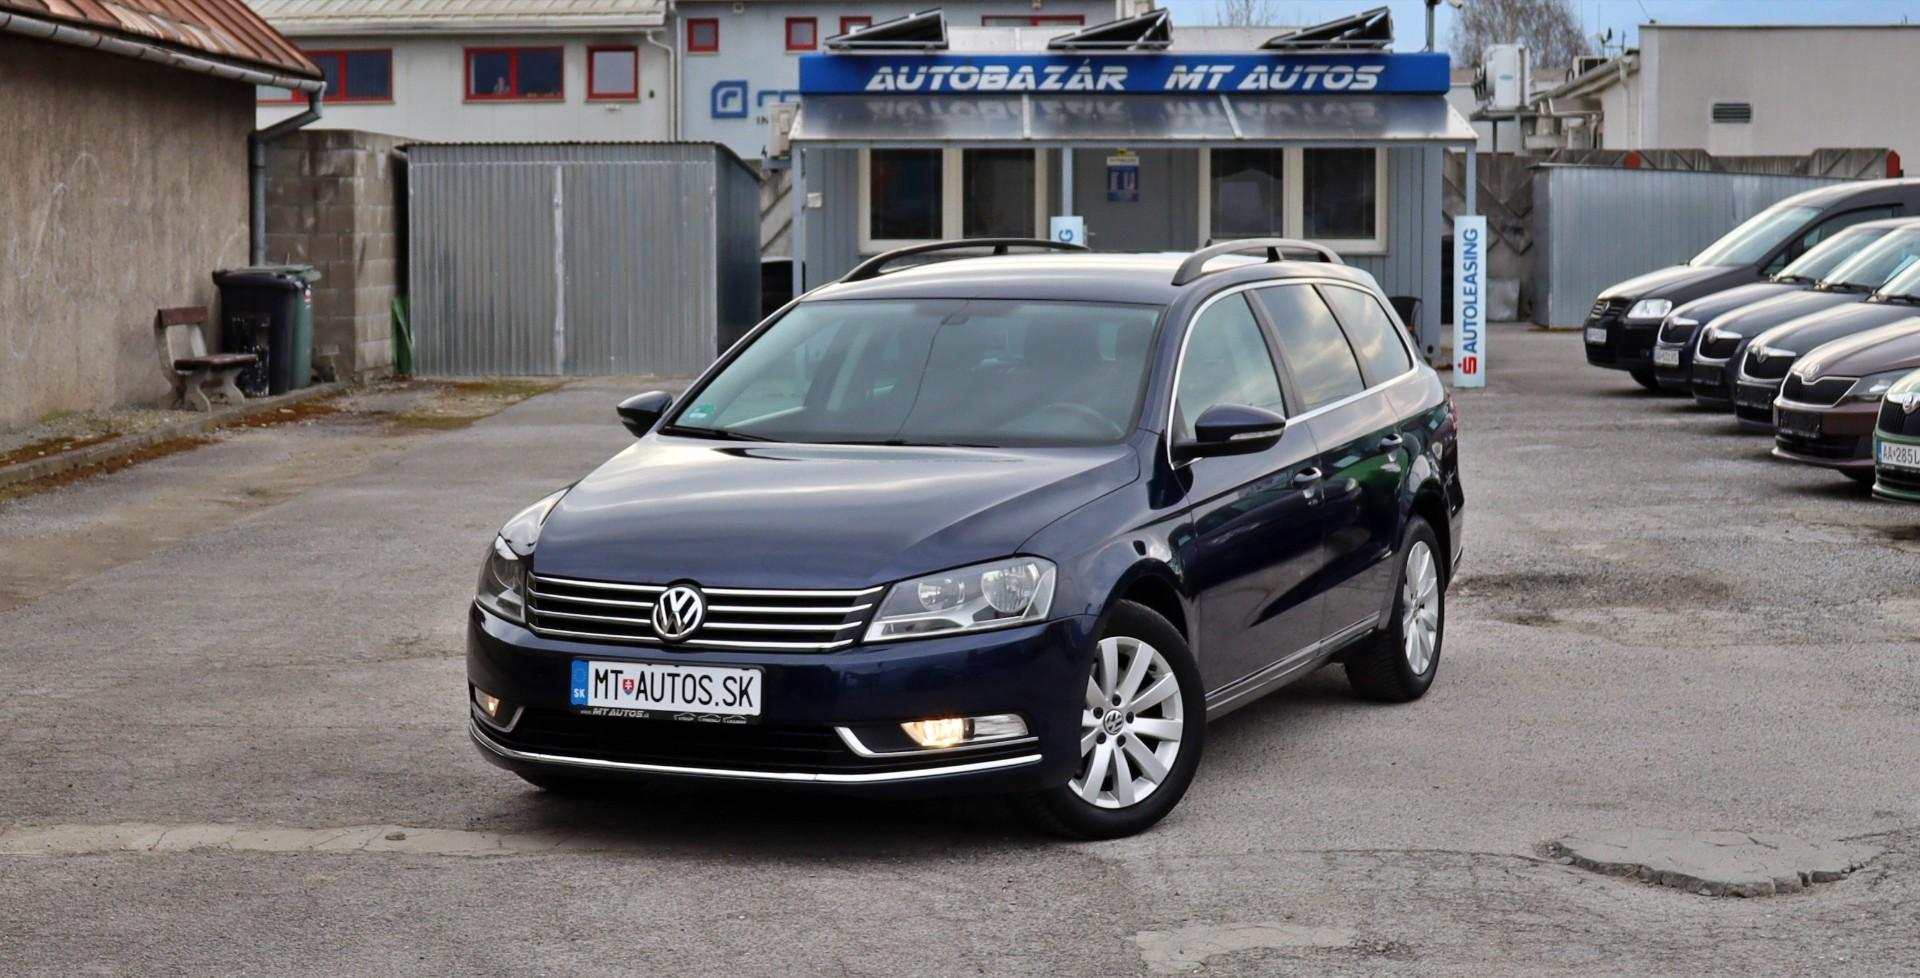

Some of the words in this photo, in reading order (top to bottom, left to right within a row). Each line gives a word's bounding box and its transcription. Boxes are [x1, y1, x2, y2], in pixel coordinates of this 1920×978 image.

[865, 59, 1128, 91] AUTOBAZÁR
[1164, 65, 1235, 90] MT
[1237, 65, 1385, 91] AUTOS
[1463, 228, 1478, 354] AUTOLEASING
[573, 688, 586, 698] SK
[594, 668, 624, 701] MT
[635, 670, 754, 708] AUTOS.SK
